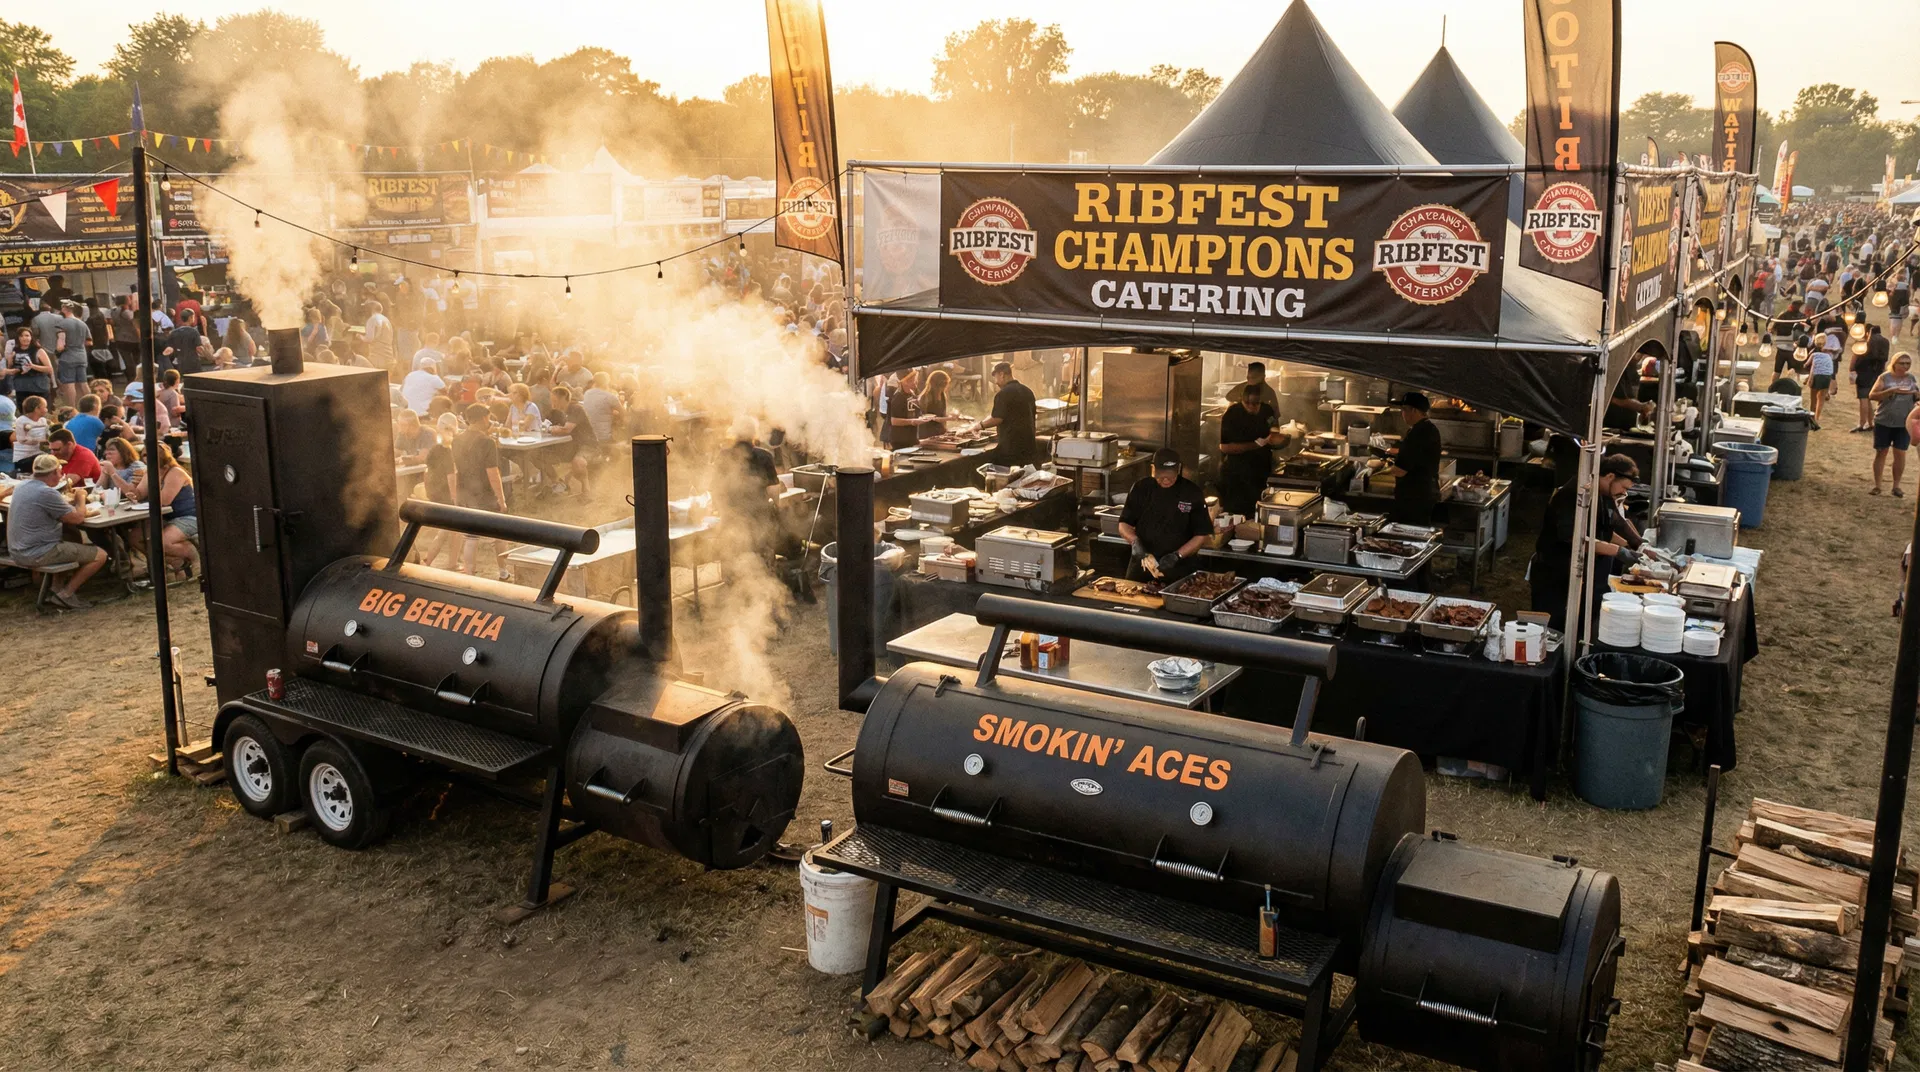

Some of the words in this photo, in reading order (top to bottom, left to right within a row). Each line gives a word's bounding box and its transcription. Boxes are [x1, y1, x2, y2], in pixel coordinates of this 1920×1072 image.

[367, 178, 439, 198] RIBFEST
[1073, 182, 1339, 228] RIBFEST
[1528, 213, 1600, 230] RIBFEST
[953, 231, 1033, 253] RIBFEST
[1540, 240, 1590, 257] CATERING
[0, 253, 34, 267] EST
[39, 248, 137, 265] CHAMPIONS
[1054, 229, 1355, 281] CHAMPIONS
[1378, 243, 1485, 266] RIBFEST
[967, 260, 1019, 279] CATERING
[1396, 277, 1464, 297] CATERING
[1091, 279, 1306, 318] CATERING
[359, 588, 406, 617] BIG
[403, 597, 506, 641] BERTHA
[973, 713, 1125, 767] SMOKIN'
[1128, 745, 1232, 791] ACES
